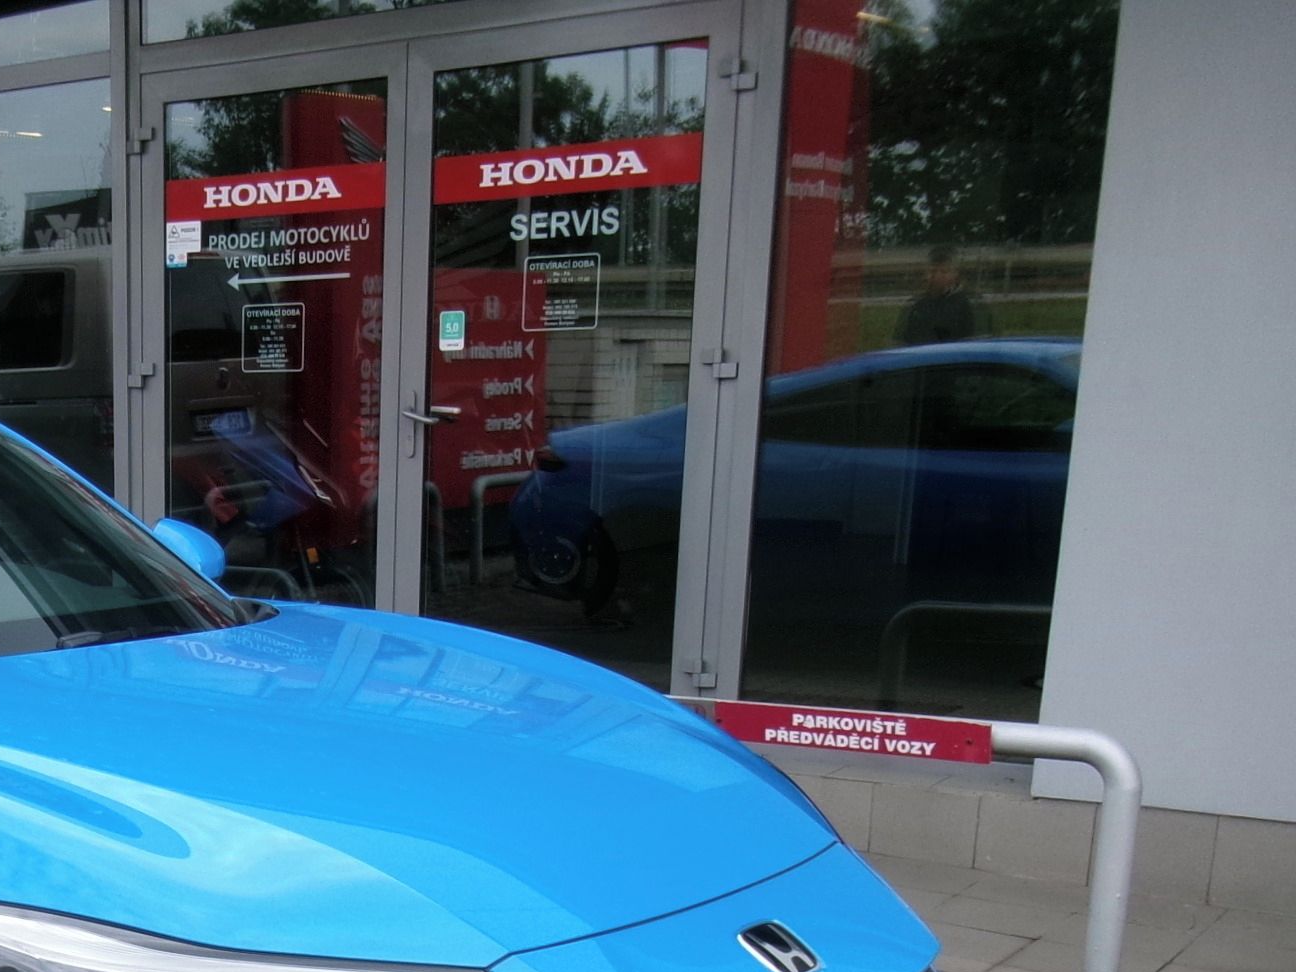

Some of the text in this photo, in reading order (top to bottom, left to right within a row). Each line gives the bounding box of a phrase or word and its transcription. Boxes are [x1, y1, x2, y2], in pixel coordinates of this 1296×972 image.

[479, 150, 648, 188] HONDA
[203, 176, 342, 209] HONDA
[208, 231, 265, 251] PRODEJ
[269, 218, 370, 246] MOTOCYKLŮ
[509, 207, 620, 241] SERVIS
[225, 246, 351, 269] VE VEDLEJŠÍ BUDOVĚ
[529, 259, 595, 271] OTEVÍRACÍ DOBA
[281, 307, 301, 317] DOBA
[791, 713, 907, 736] PARKOVIŠTĚ
[764, 727, 936, 756] PŘEDVÁDĚCÍ VOZY
